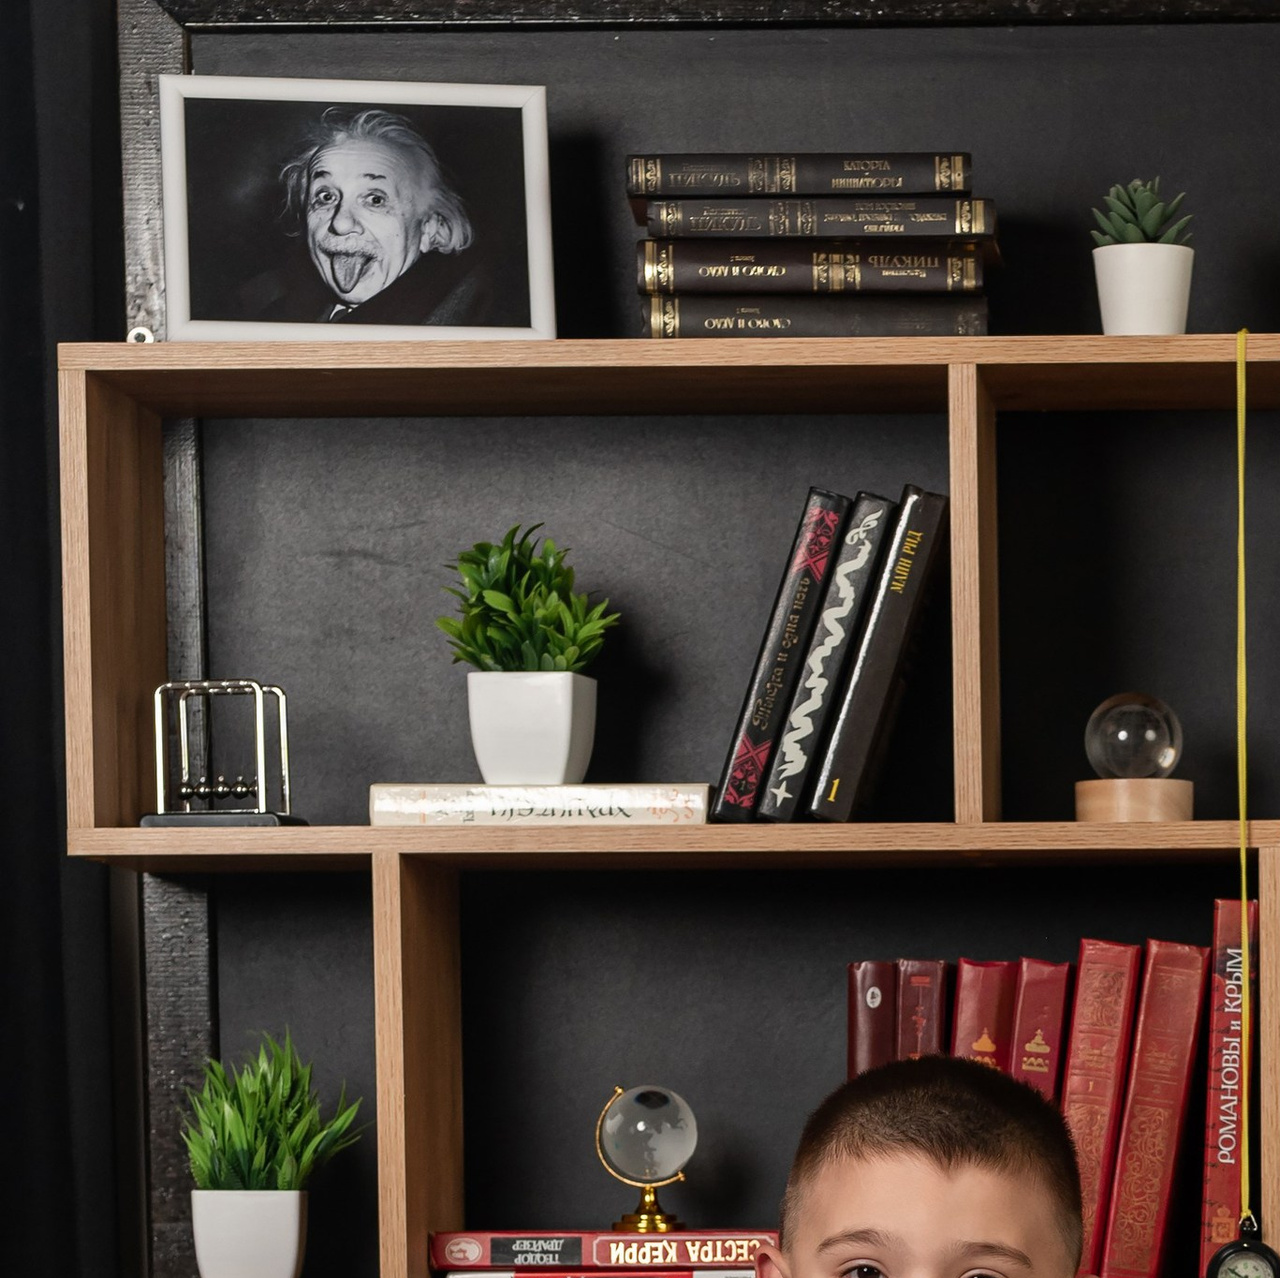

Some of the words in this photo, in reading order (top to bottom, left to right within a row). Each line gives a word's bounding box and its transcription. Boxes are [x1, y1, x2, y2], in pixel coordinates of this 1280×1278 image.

[844, 160, 890, 171] КАТОРГА
[831, 177, 903, 189] МИНИАТЮРЫ
[868, 255, 939, 268] ПИКУЛЬ
[742, 266, 786, 277] СЛОВО
[747, 318, 791, 329] СЛОВО
[889, 557, 913, 594] МАЙН
[903, 530, 922, 555] РИД
[780, 613, 801, 650] одна
[791, 577, 811, 611] ночь
[827, 777, 841, 803] 1
[1224, 947, 1244, 1015] КРЫМ
[1229, 1020, 1241, 1033] и
[1217, 1034, 1242, 1165] РОМАНОВЫ
[513, 1238, 564, 1253] ДРАЙЗЕР
[609, 1239, 678, 1265] КЕРРИ
[686, 1239, 760, 1264] СЕСТРА
[513, 1252, 559, 1265] ТЕОДОР
